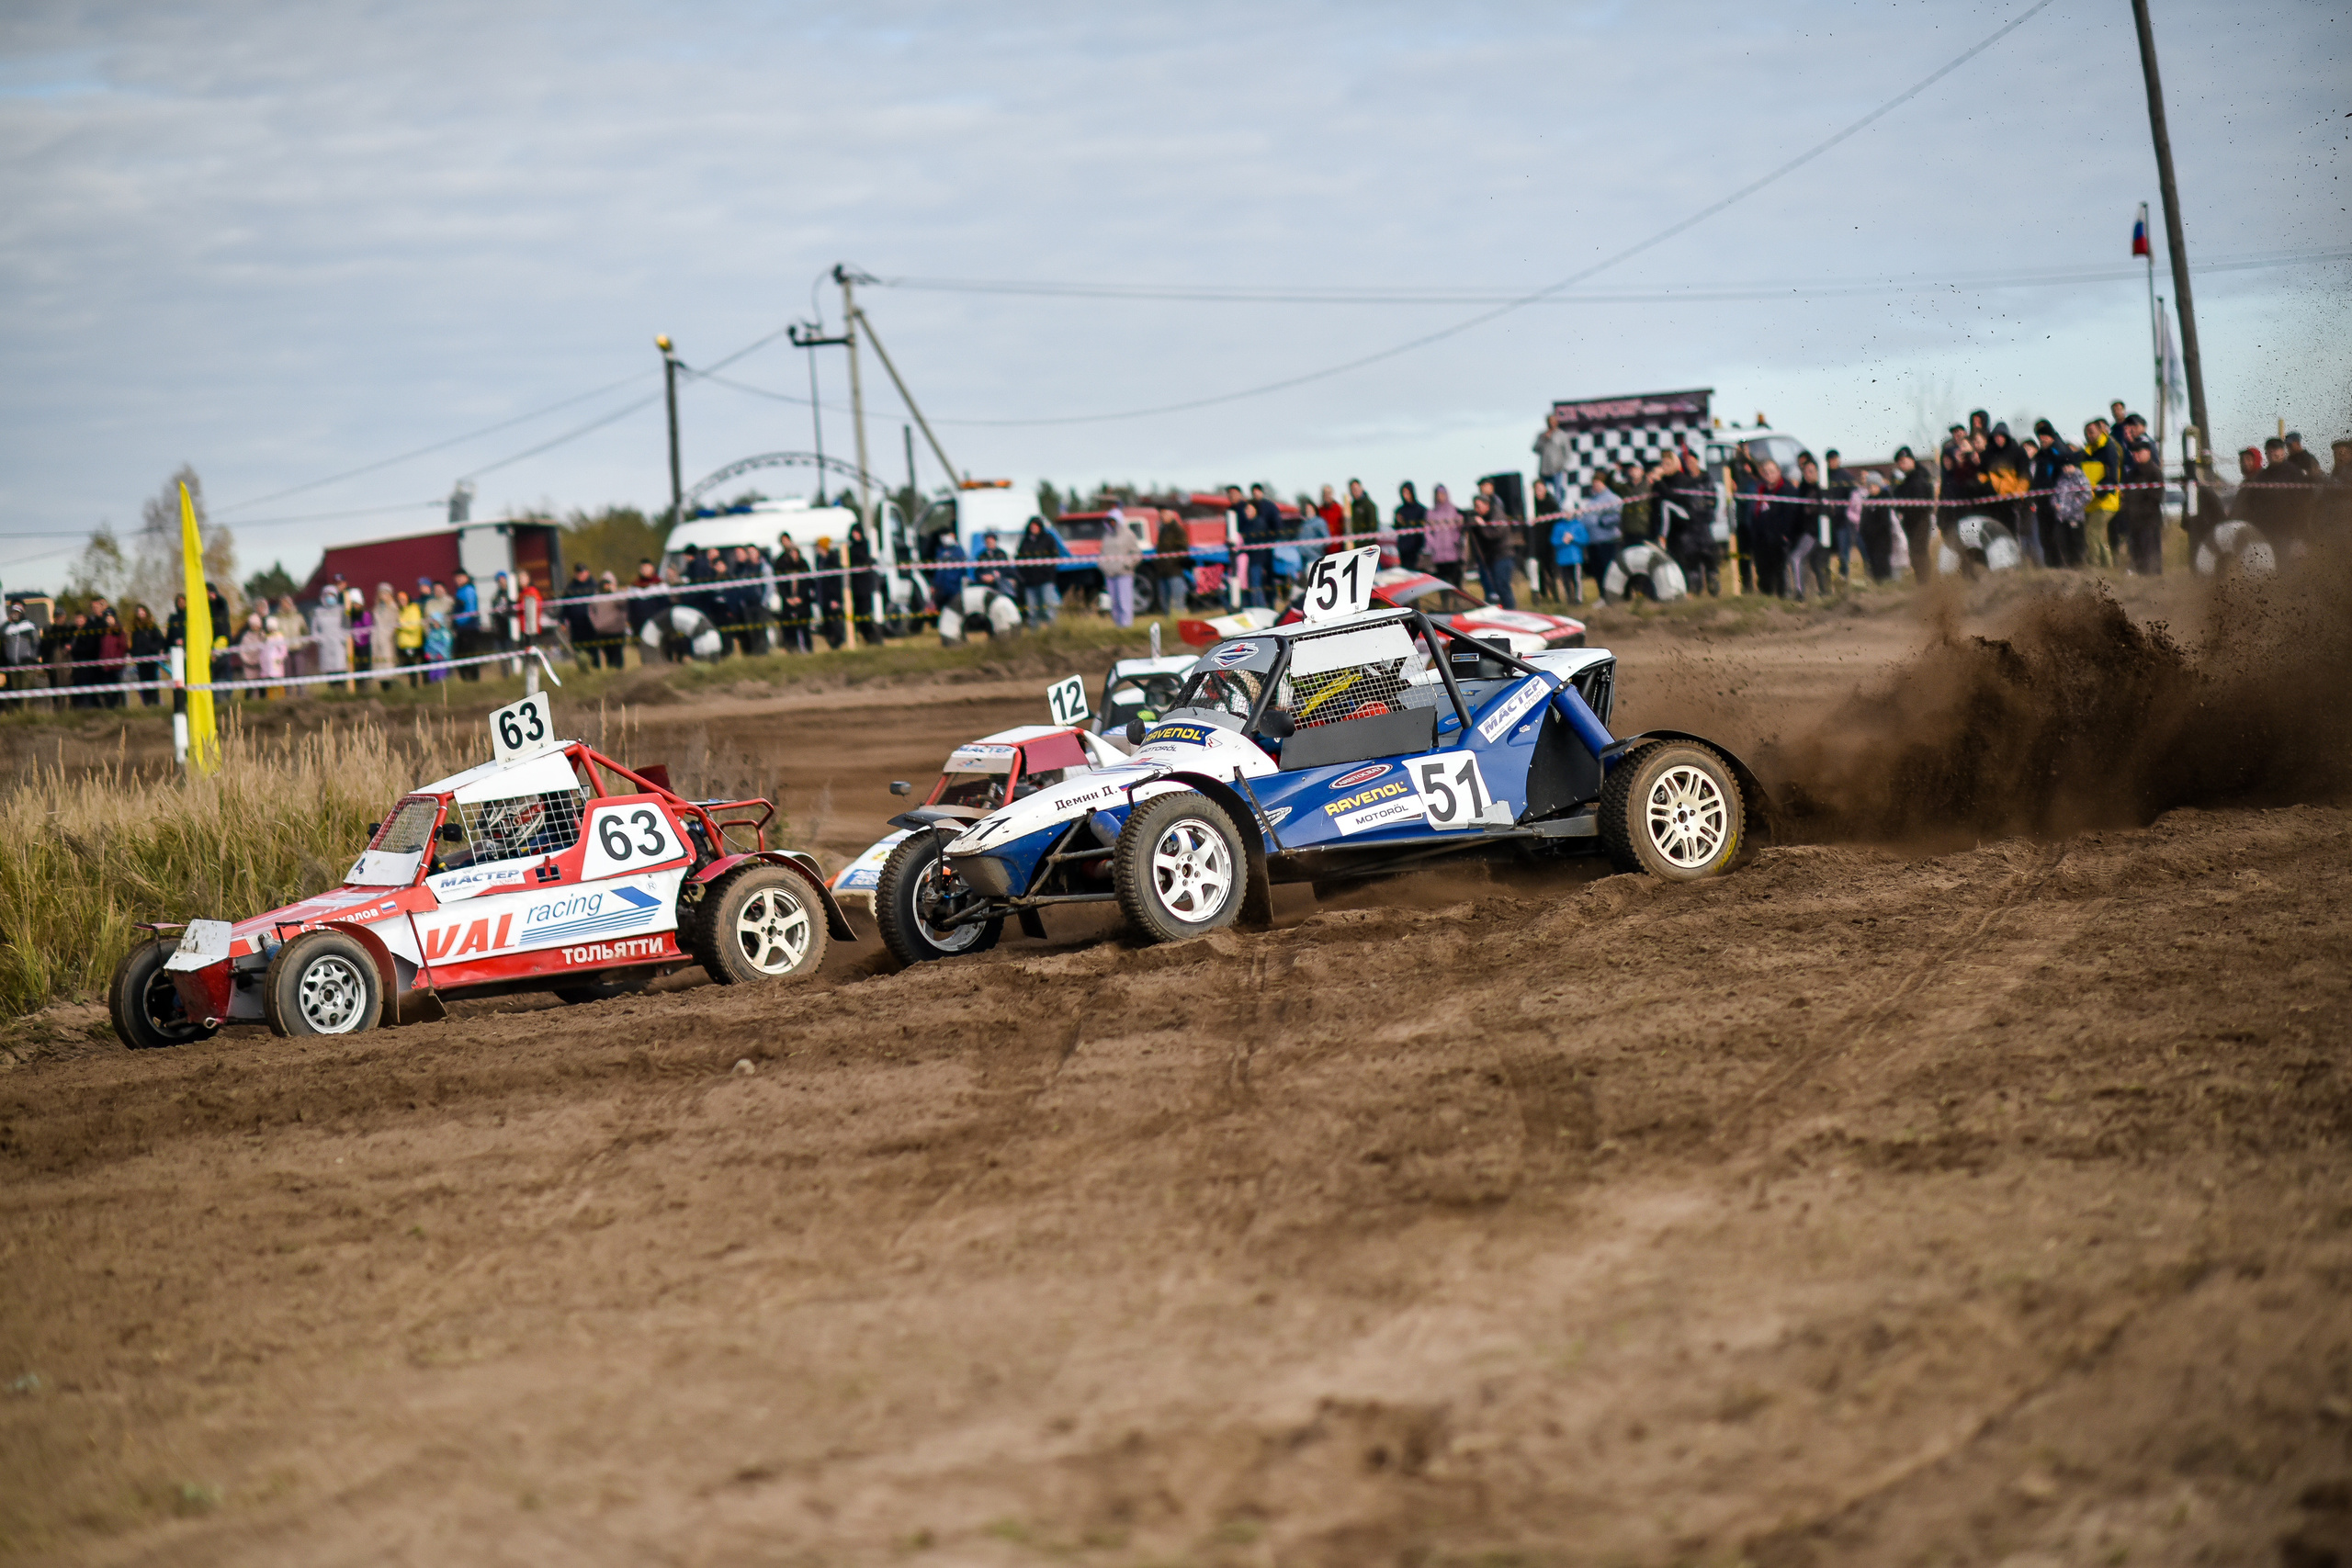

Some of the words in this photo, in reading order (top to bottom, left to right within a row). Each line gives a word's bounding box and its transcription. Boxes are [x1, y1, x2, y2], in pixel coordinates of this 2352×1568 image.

[1316, 554, 1359, 610] 51
[1052, 681, 1085, 721] 12
[1484, 678, 1541, 734] МАСТЕР
[499, 702, 545, 750] 63
[1054, 790, 1100, 811] Демин
[1102, 785, 1118, 797] Д.
[1324, 781, 1408, 817] RAVENOL
[1421, 759, 1484, 822] 51
[598, 809, 666, 861] 63
[1355, 804, 1409, 826] MOTORÖL
[440, 869, 520, 889] МАСТЕР
[425, 912, 514, 961] VAL
[526, 893, 604, 924] racing
[561, 937, 663, 964] ТОЛЬЯТТИ
